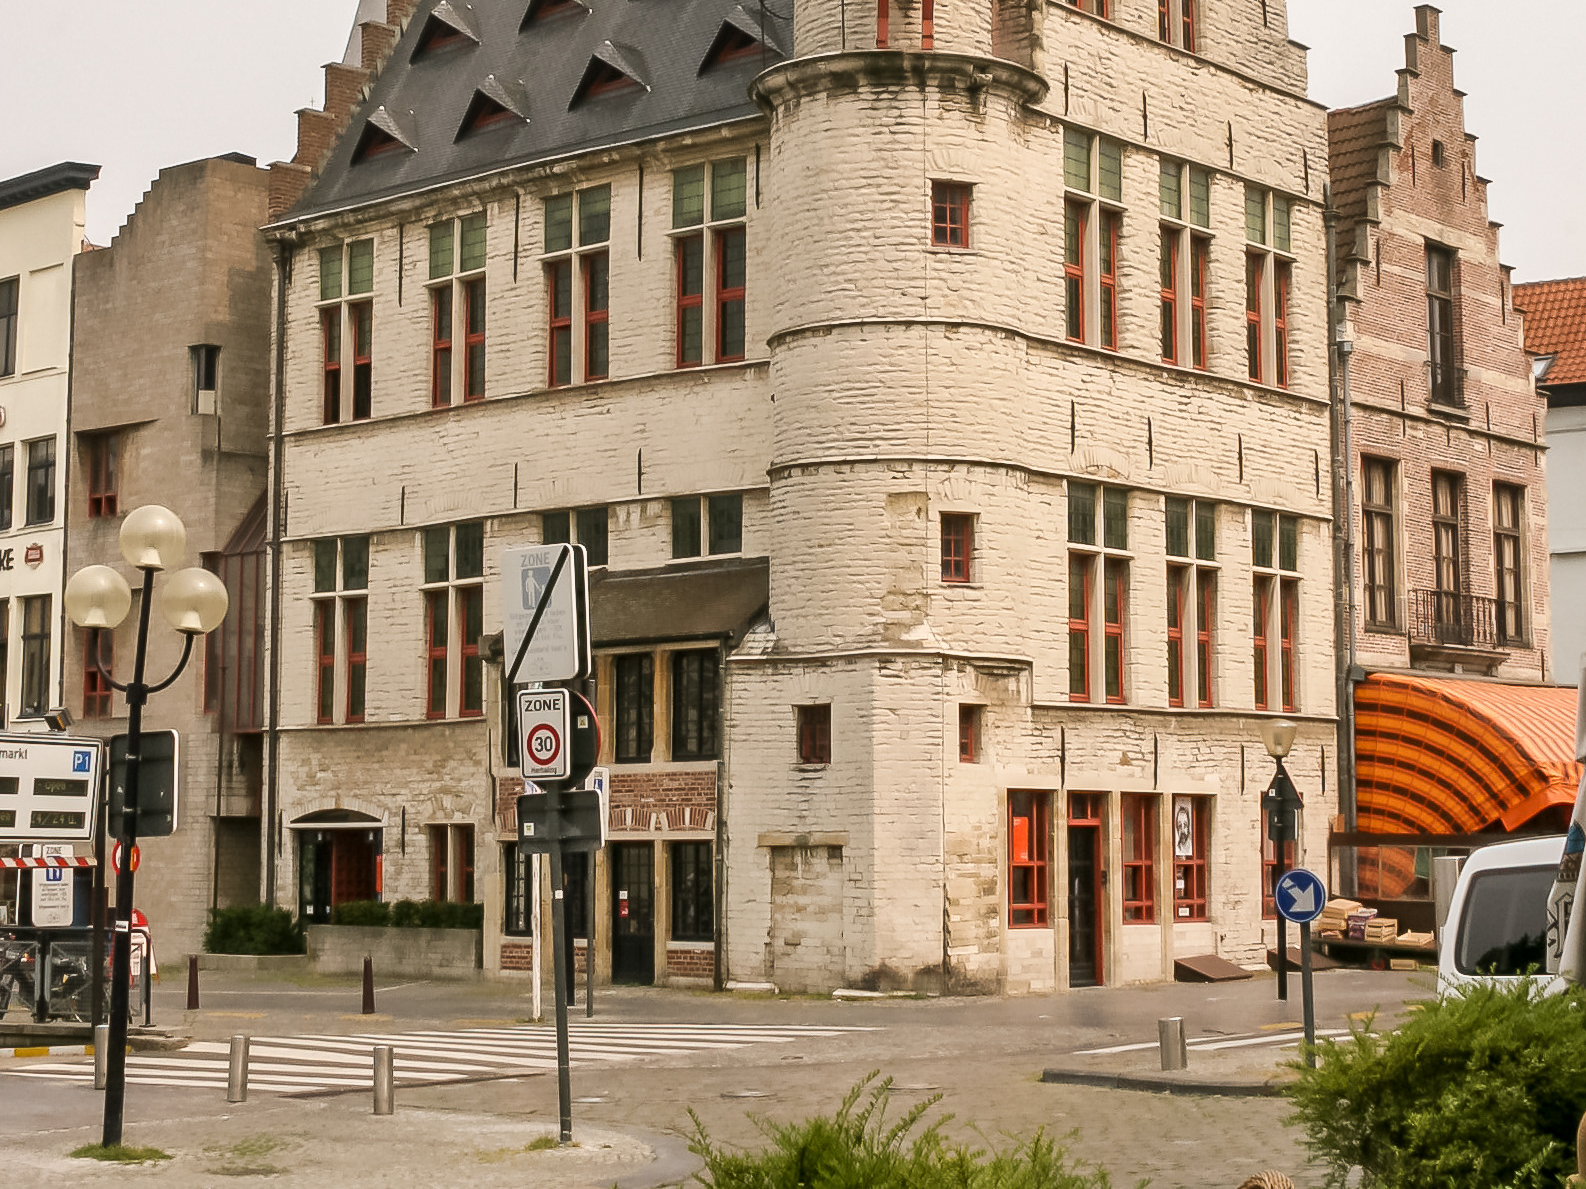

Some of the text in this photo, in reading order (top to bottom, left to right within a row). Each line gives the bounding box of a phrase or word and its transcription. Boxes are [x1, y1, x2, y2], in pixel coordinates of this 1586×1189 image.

[521, 552, 550, 567] ZONE
[525, 699, 560, 712] ZONE
[535, 736, 552, 752] 30
[74, 753, 89, 770] P1
